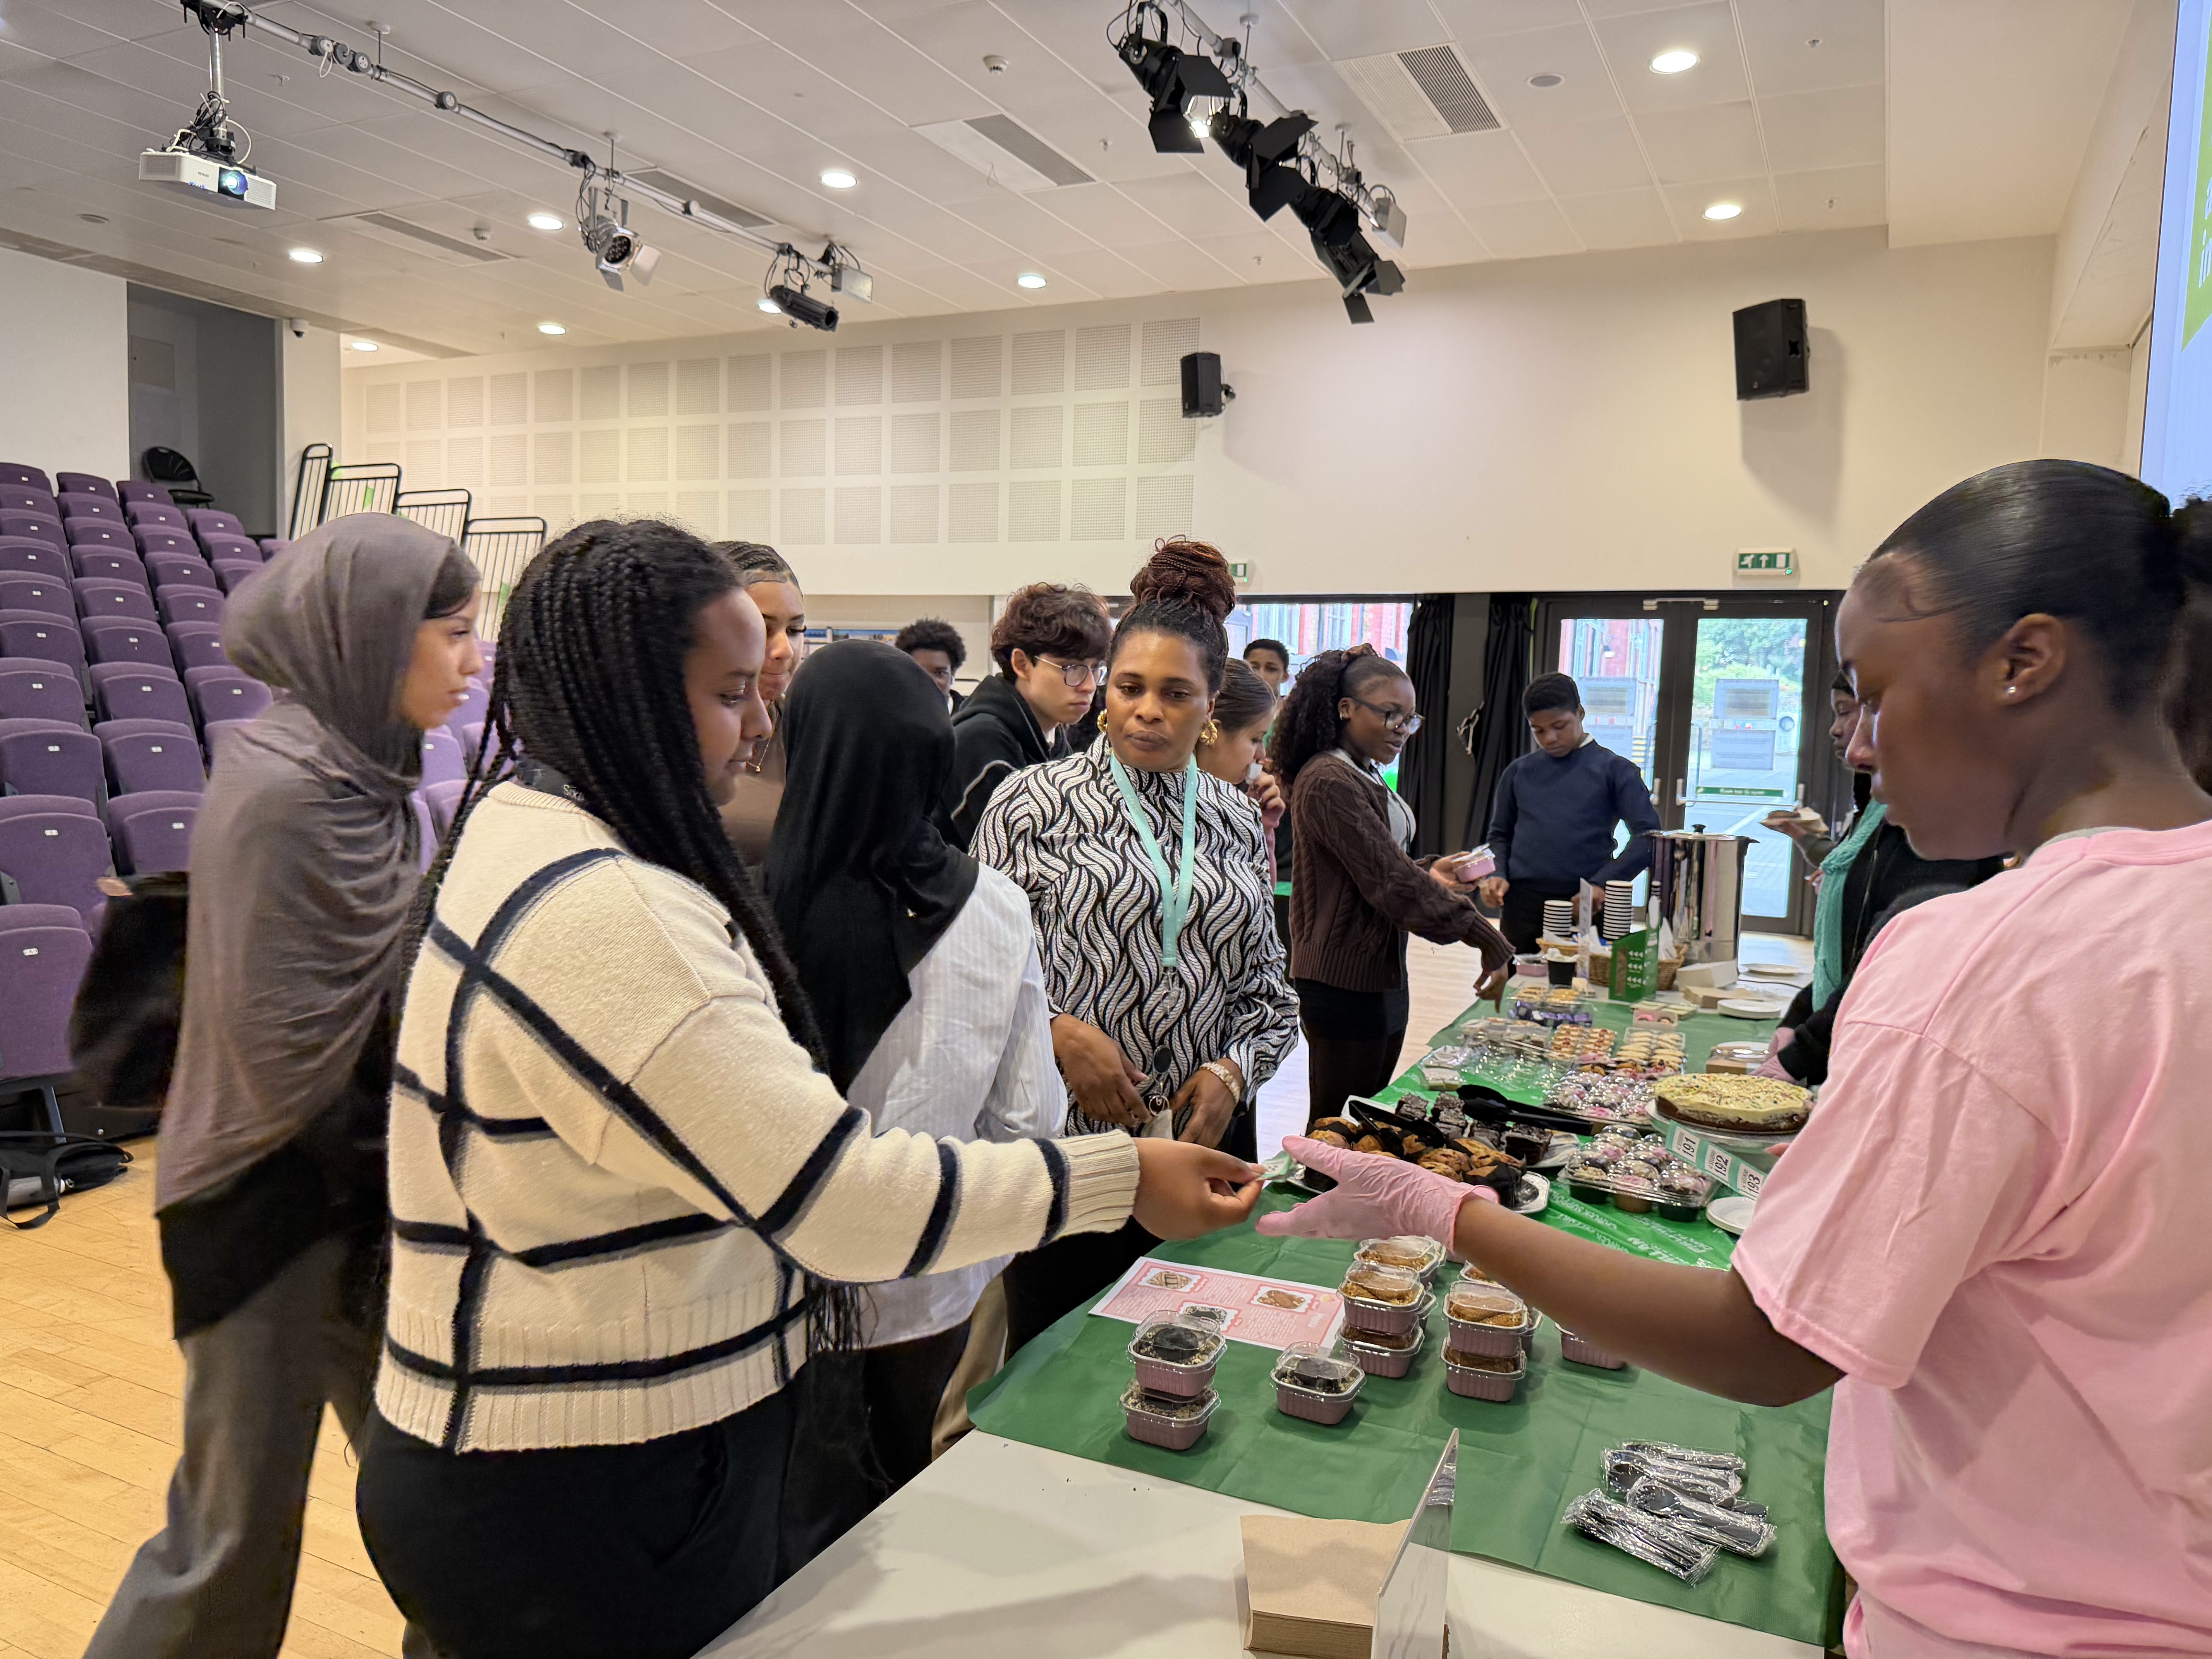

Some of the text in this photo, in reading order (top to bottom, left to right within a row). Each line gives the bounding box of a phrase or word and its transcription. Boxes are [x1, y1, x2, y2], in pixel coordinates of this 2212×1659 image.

[1126, 794, 1139, 811] STAFF
[1683, 1137, 1696, 1157] 191
[1714, 1155, 1728, 1176] 192
[1747, 1173, 1760, 1194] 193
